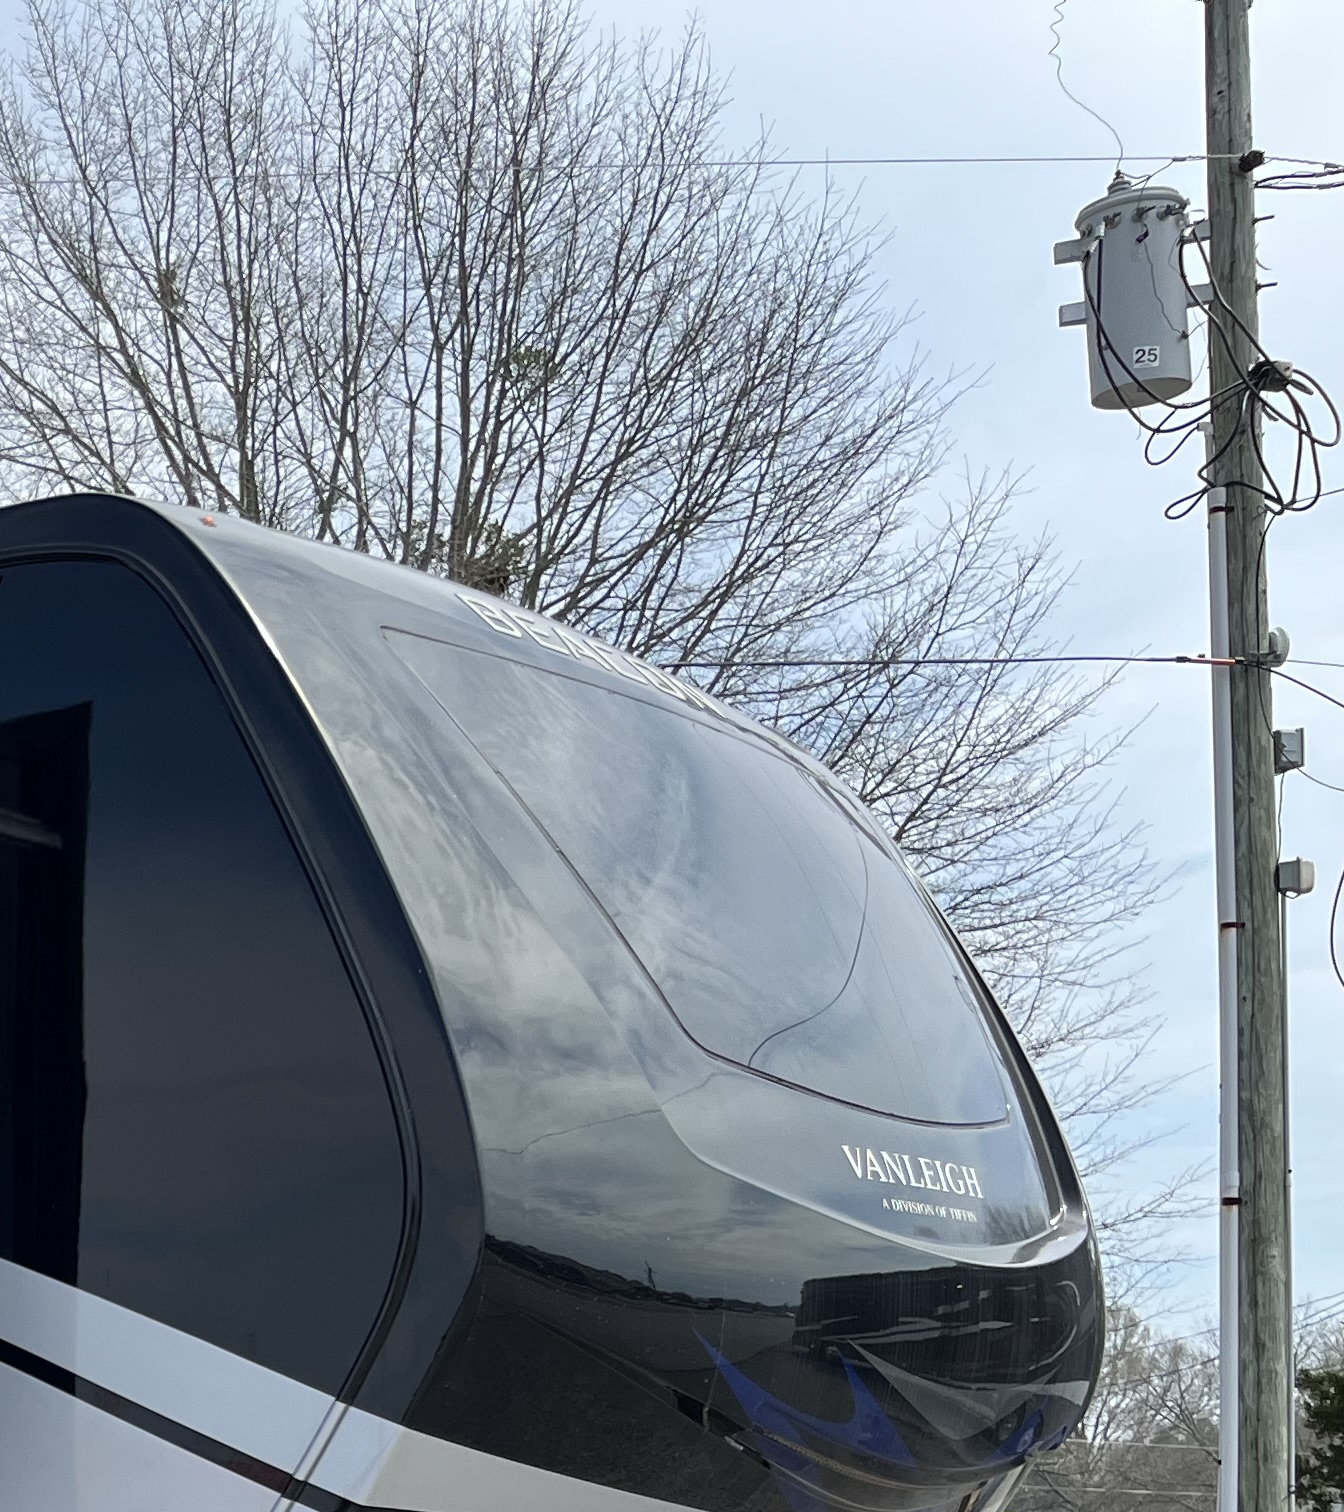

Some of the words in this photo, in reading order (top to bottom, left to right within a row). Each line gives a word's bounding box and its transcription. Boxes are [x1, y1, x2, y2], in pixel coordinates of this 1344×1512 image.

[1135, 348, 1158, 364] 25
[841, 1144, 985, 1199] VANLEIGH
[882, 1198, 891, 1210] A
[891, 1198, 935, 1216] DIVISION
[935, 1205, 947, 1218] OF
[949, 1207, 978, 1223] TIFFIN
